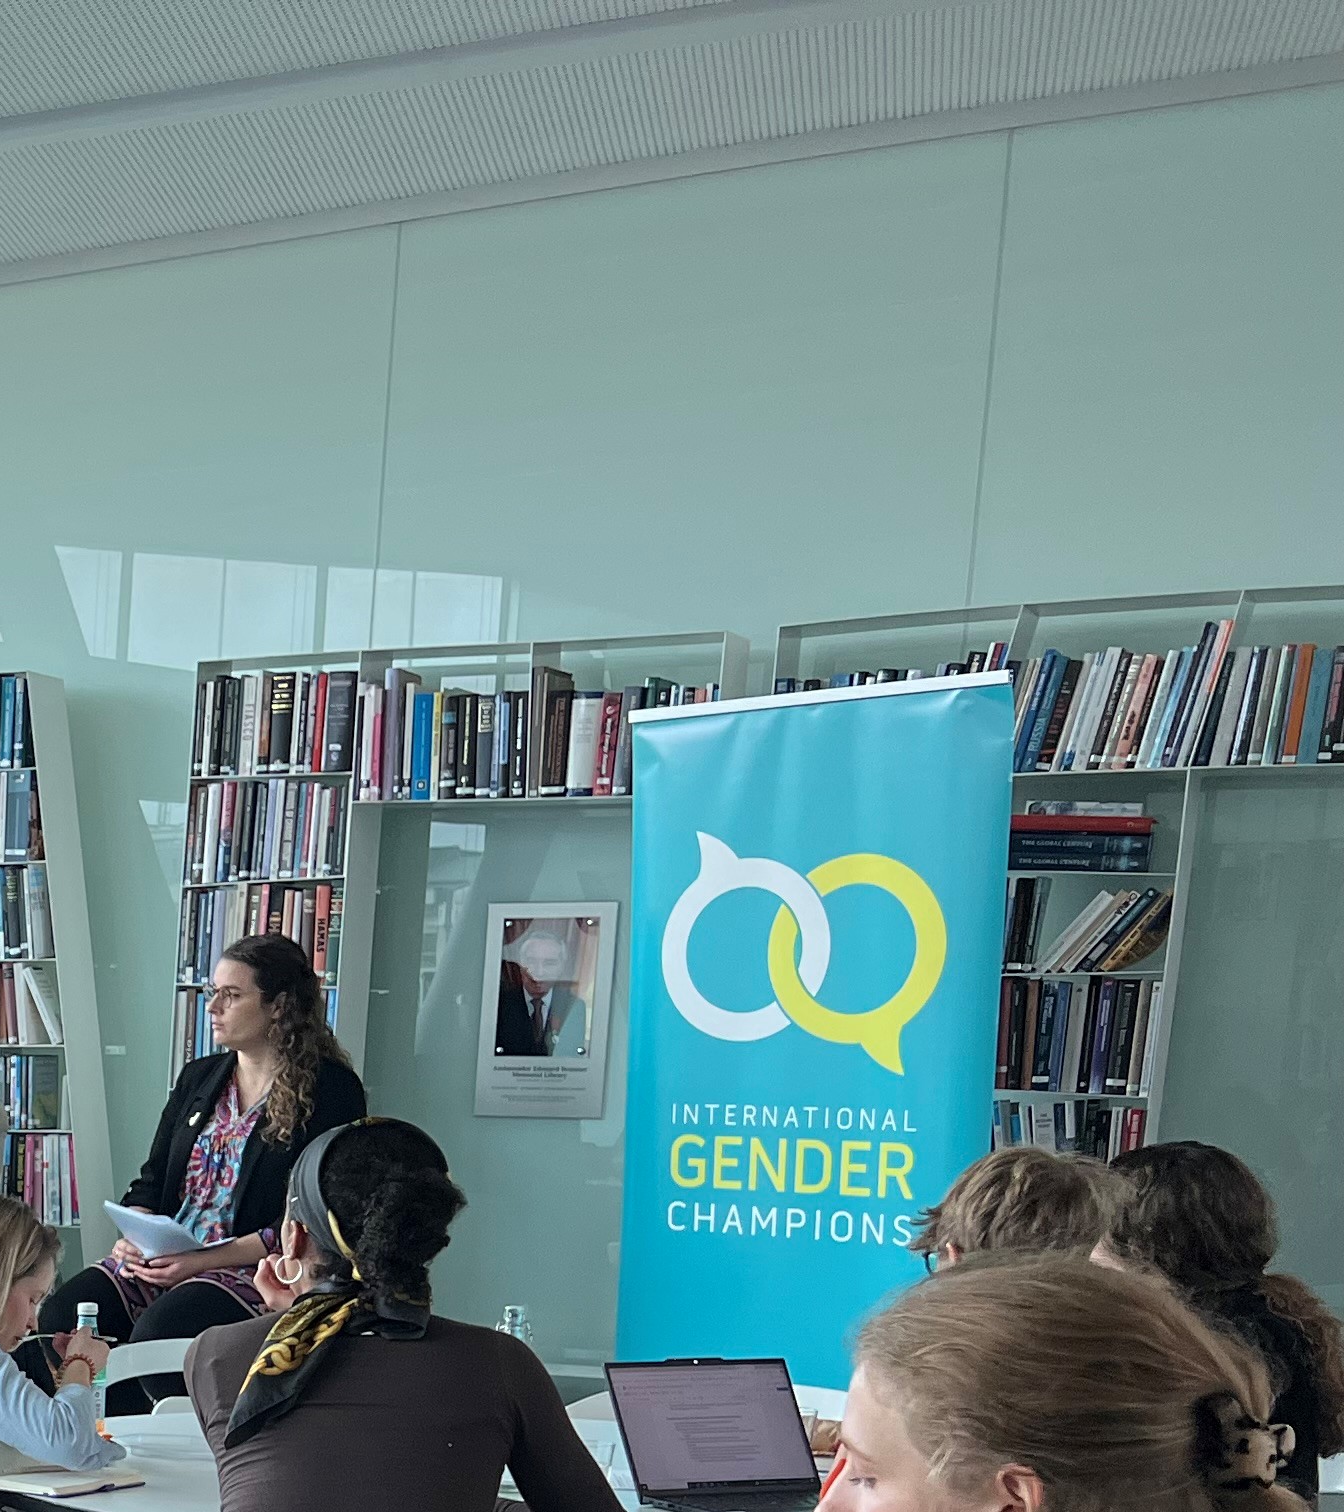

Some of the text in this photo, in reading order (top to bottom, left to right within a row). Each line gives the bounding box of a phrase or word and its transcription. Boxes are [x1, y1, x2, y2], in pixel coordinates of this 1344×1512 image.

[1027, 717, 1048, 752] RUSSIA
[316, 917, 326, 953] HAMAS
[671, 1103, 917, 1132] INTERNATIONAL
[670, 1133, 914, 1199] GENDER
[667, 1200, 913, 1247] CHAMPIONS
